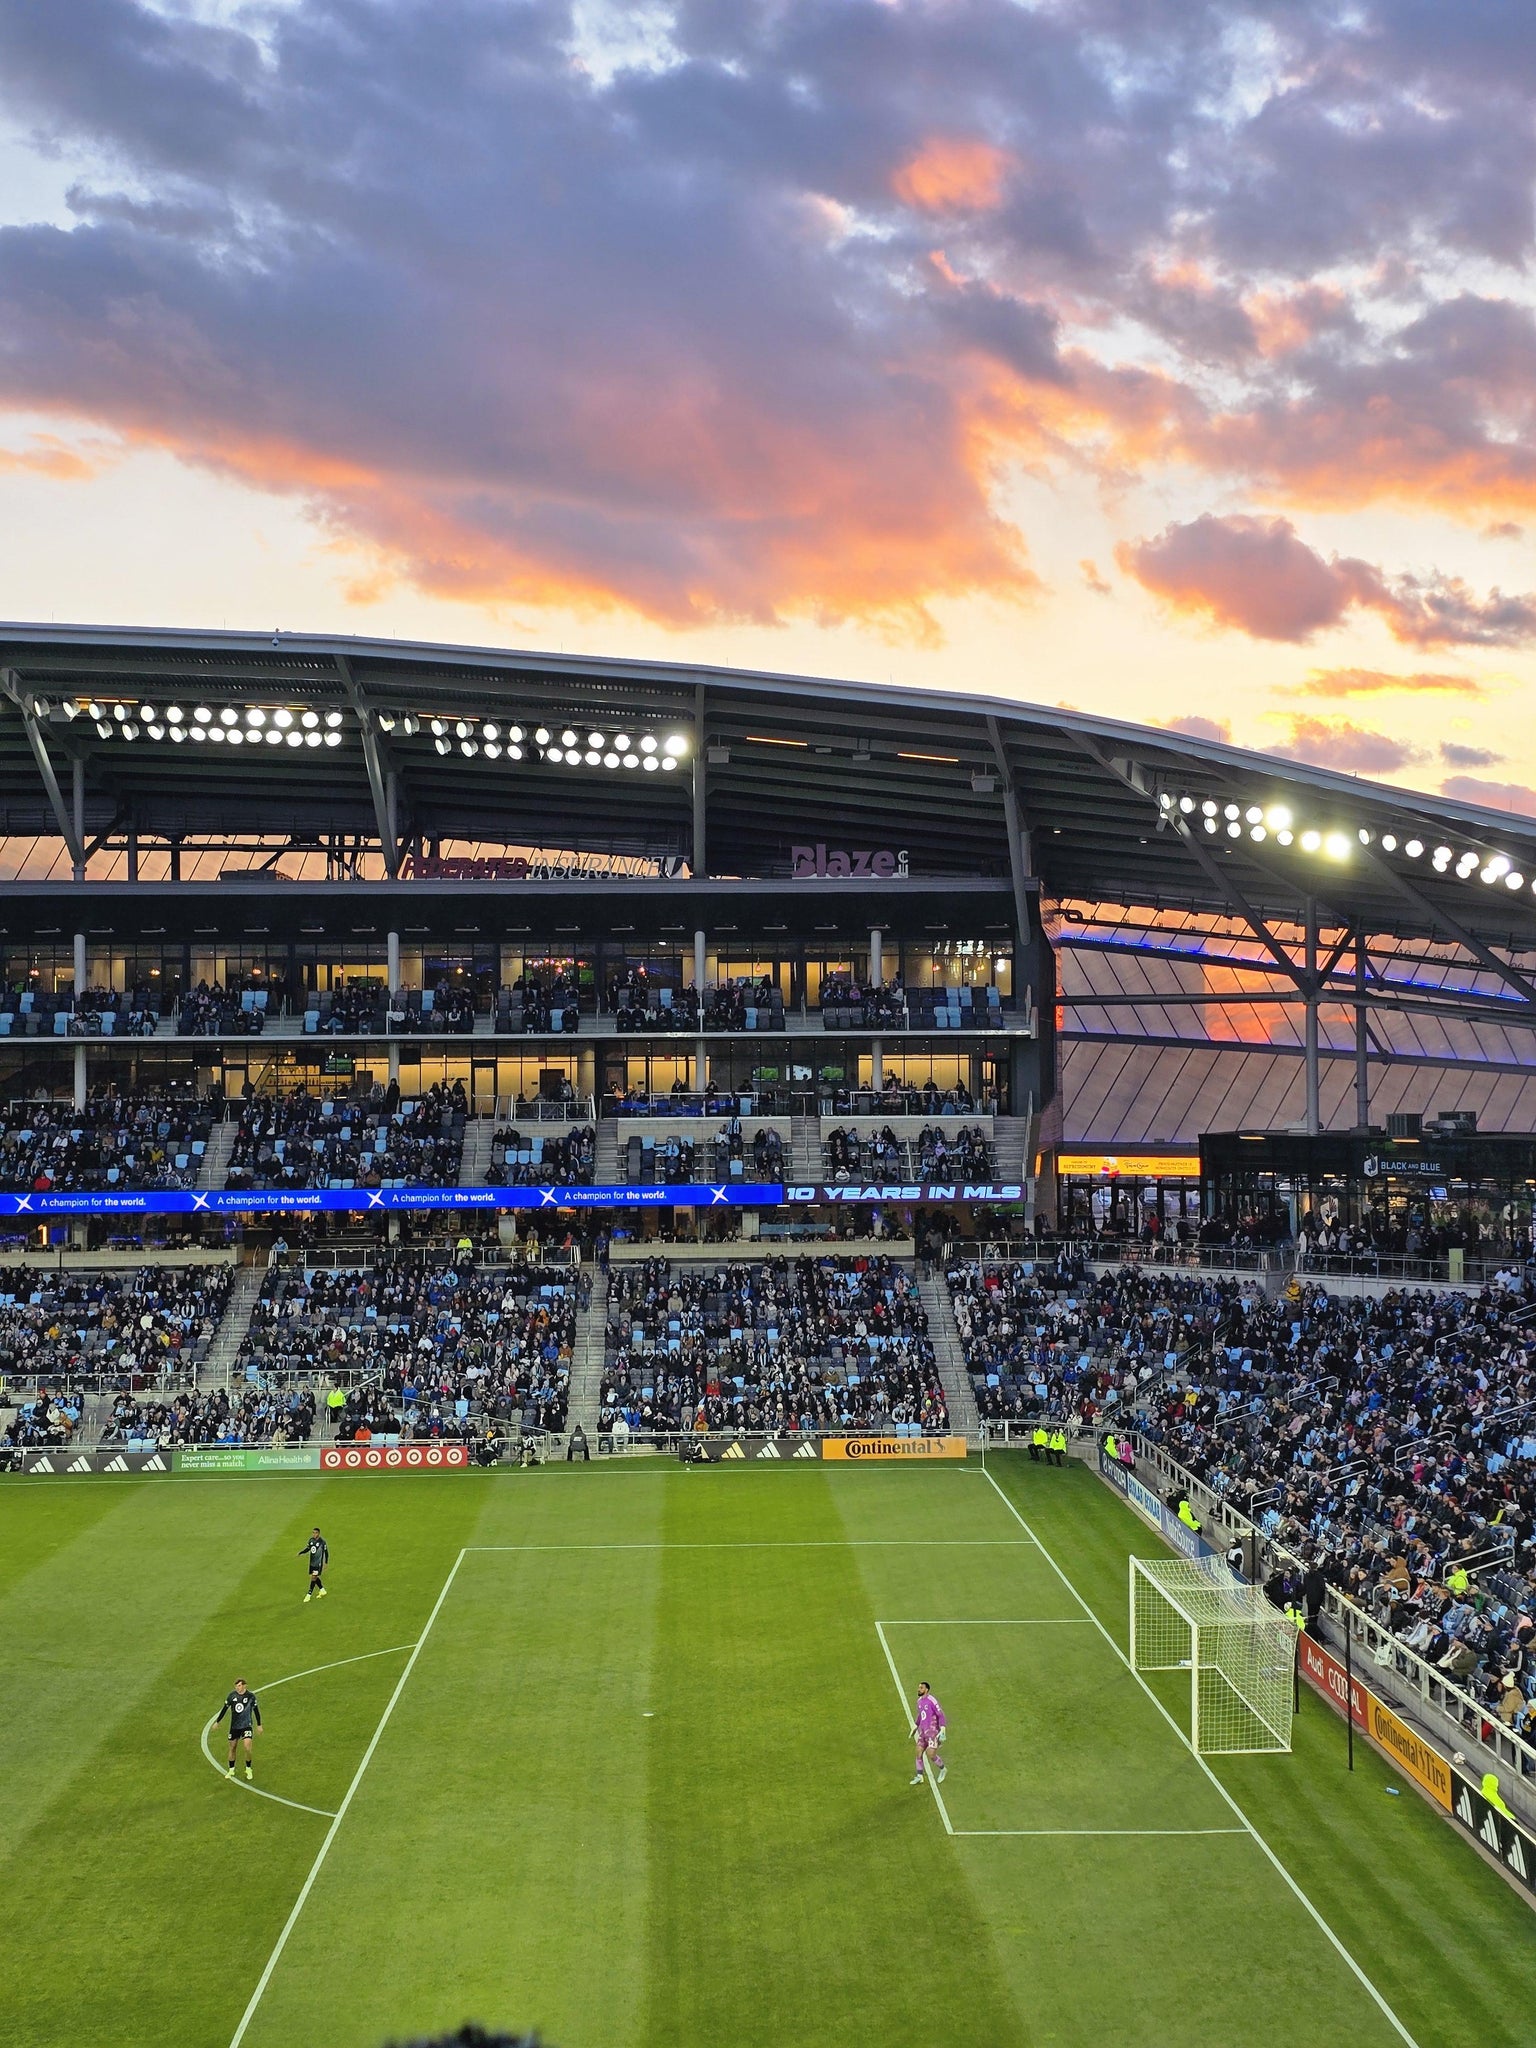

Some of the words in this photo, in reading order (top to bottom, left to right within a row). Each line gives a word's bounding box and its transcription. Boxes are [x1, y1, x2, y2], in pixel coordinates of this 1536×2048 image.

[792, 844, 896, 877] Blaze
[1381, 1161, 1407, 1170] BLACK
[1420, 1162, 1441, 1171] BLUE
[392, 1194, 399, 1202] A
[401, 1194, 439, 1203] champion
[441, 1193, 453, 1201] for
[470, 1193, 496, 1201] world.
[564, 1192, 571, 1200] A
[573, 1191, 611, 1201] champion
[613, 1191, 624, 1199] for
[626, 1191, 640, 1199] the
[641, 1191, 667, 1199] world.
[786, 1187, 816, 1200] 10
[823, 1186, 921, 1200] YEARS
[928, 1186, 956, 1199] IN
[962, 1186, 1021, 1199] MLS
[49, 1198, 89, 1208] champion
[91, 1198, 102, 1206] for
[105, 1198, 119, 1206] the
[120, 1198, 146, 1206] world.
[226, 1196, 265, 1205] champion
[267, 1196, 278, 1204] for
[281, 1196, 295, 1204] the
[296, 1195, 322, 1203] world.
[845, 1440, 932, 1458] Continental
[181, 1454, 203, 1462] Expert
[222, 1460, 246, 1468] match.
[1307, 1647, 1324, 1679] Audi
[1375, 1706, 1419, 1770] Continental
[1424, 1749, 1446, 1794] Tire
